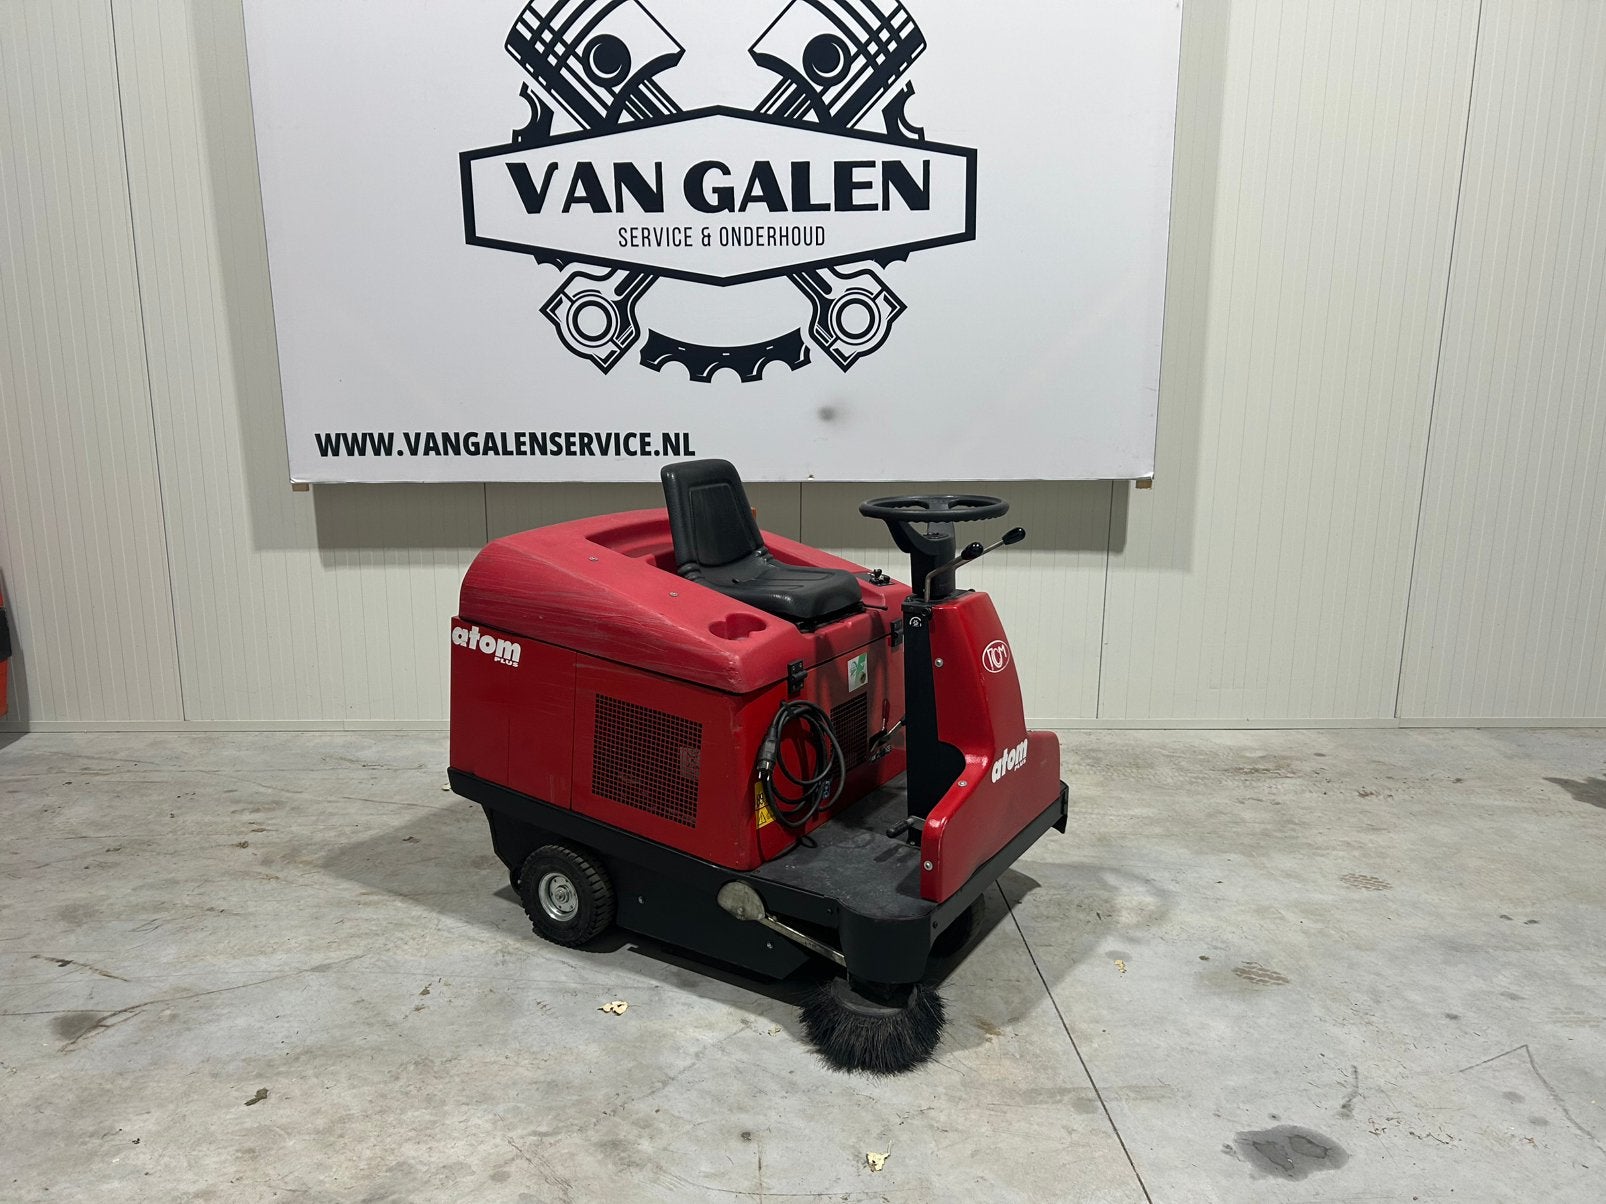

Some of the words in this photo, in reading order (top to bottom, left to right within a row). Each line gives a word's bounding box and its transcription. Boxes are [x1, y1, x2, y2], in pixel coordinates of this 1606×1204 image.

[505, 161, 665, 215] VAN
[683, 159, 931, 214] GALEN
[618, 226, 693, 248] SERVICE
[701, 226, 712, 247] &
[719, 225, 825, 247] ONDERHOUD
[314, 431, 696, 457] WWW.VANGALENSERVICE.NL
[452, 625, 521, 662] atom
[494, 656, 519, 667] PLUS
[991, 738, 1028, 783] atom
